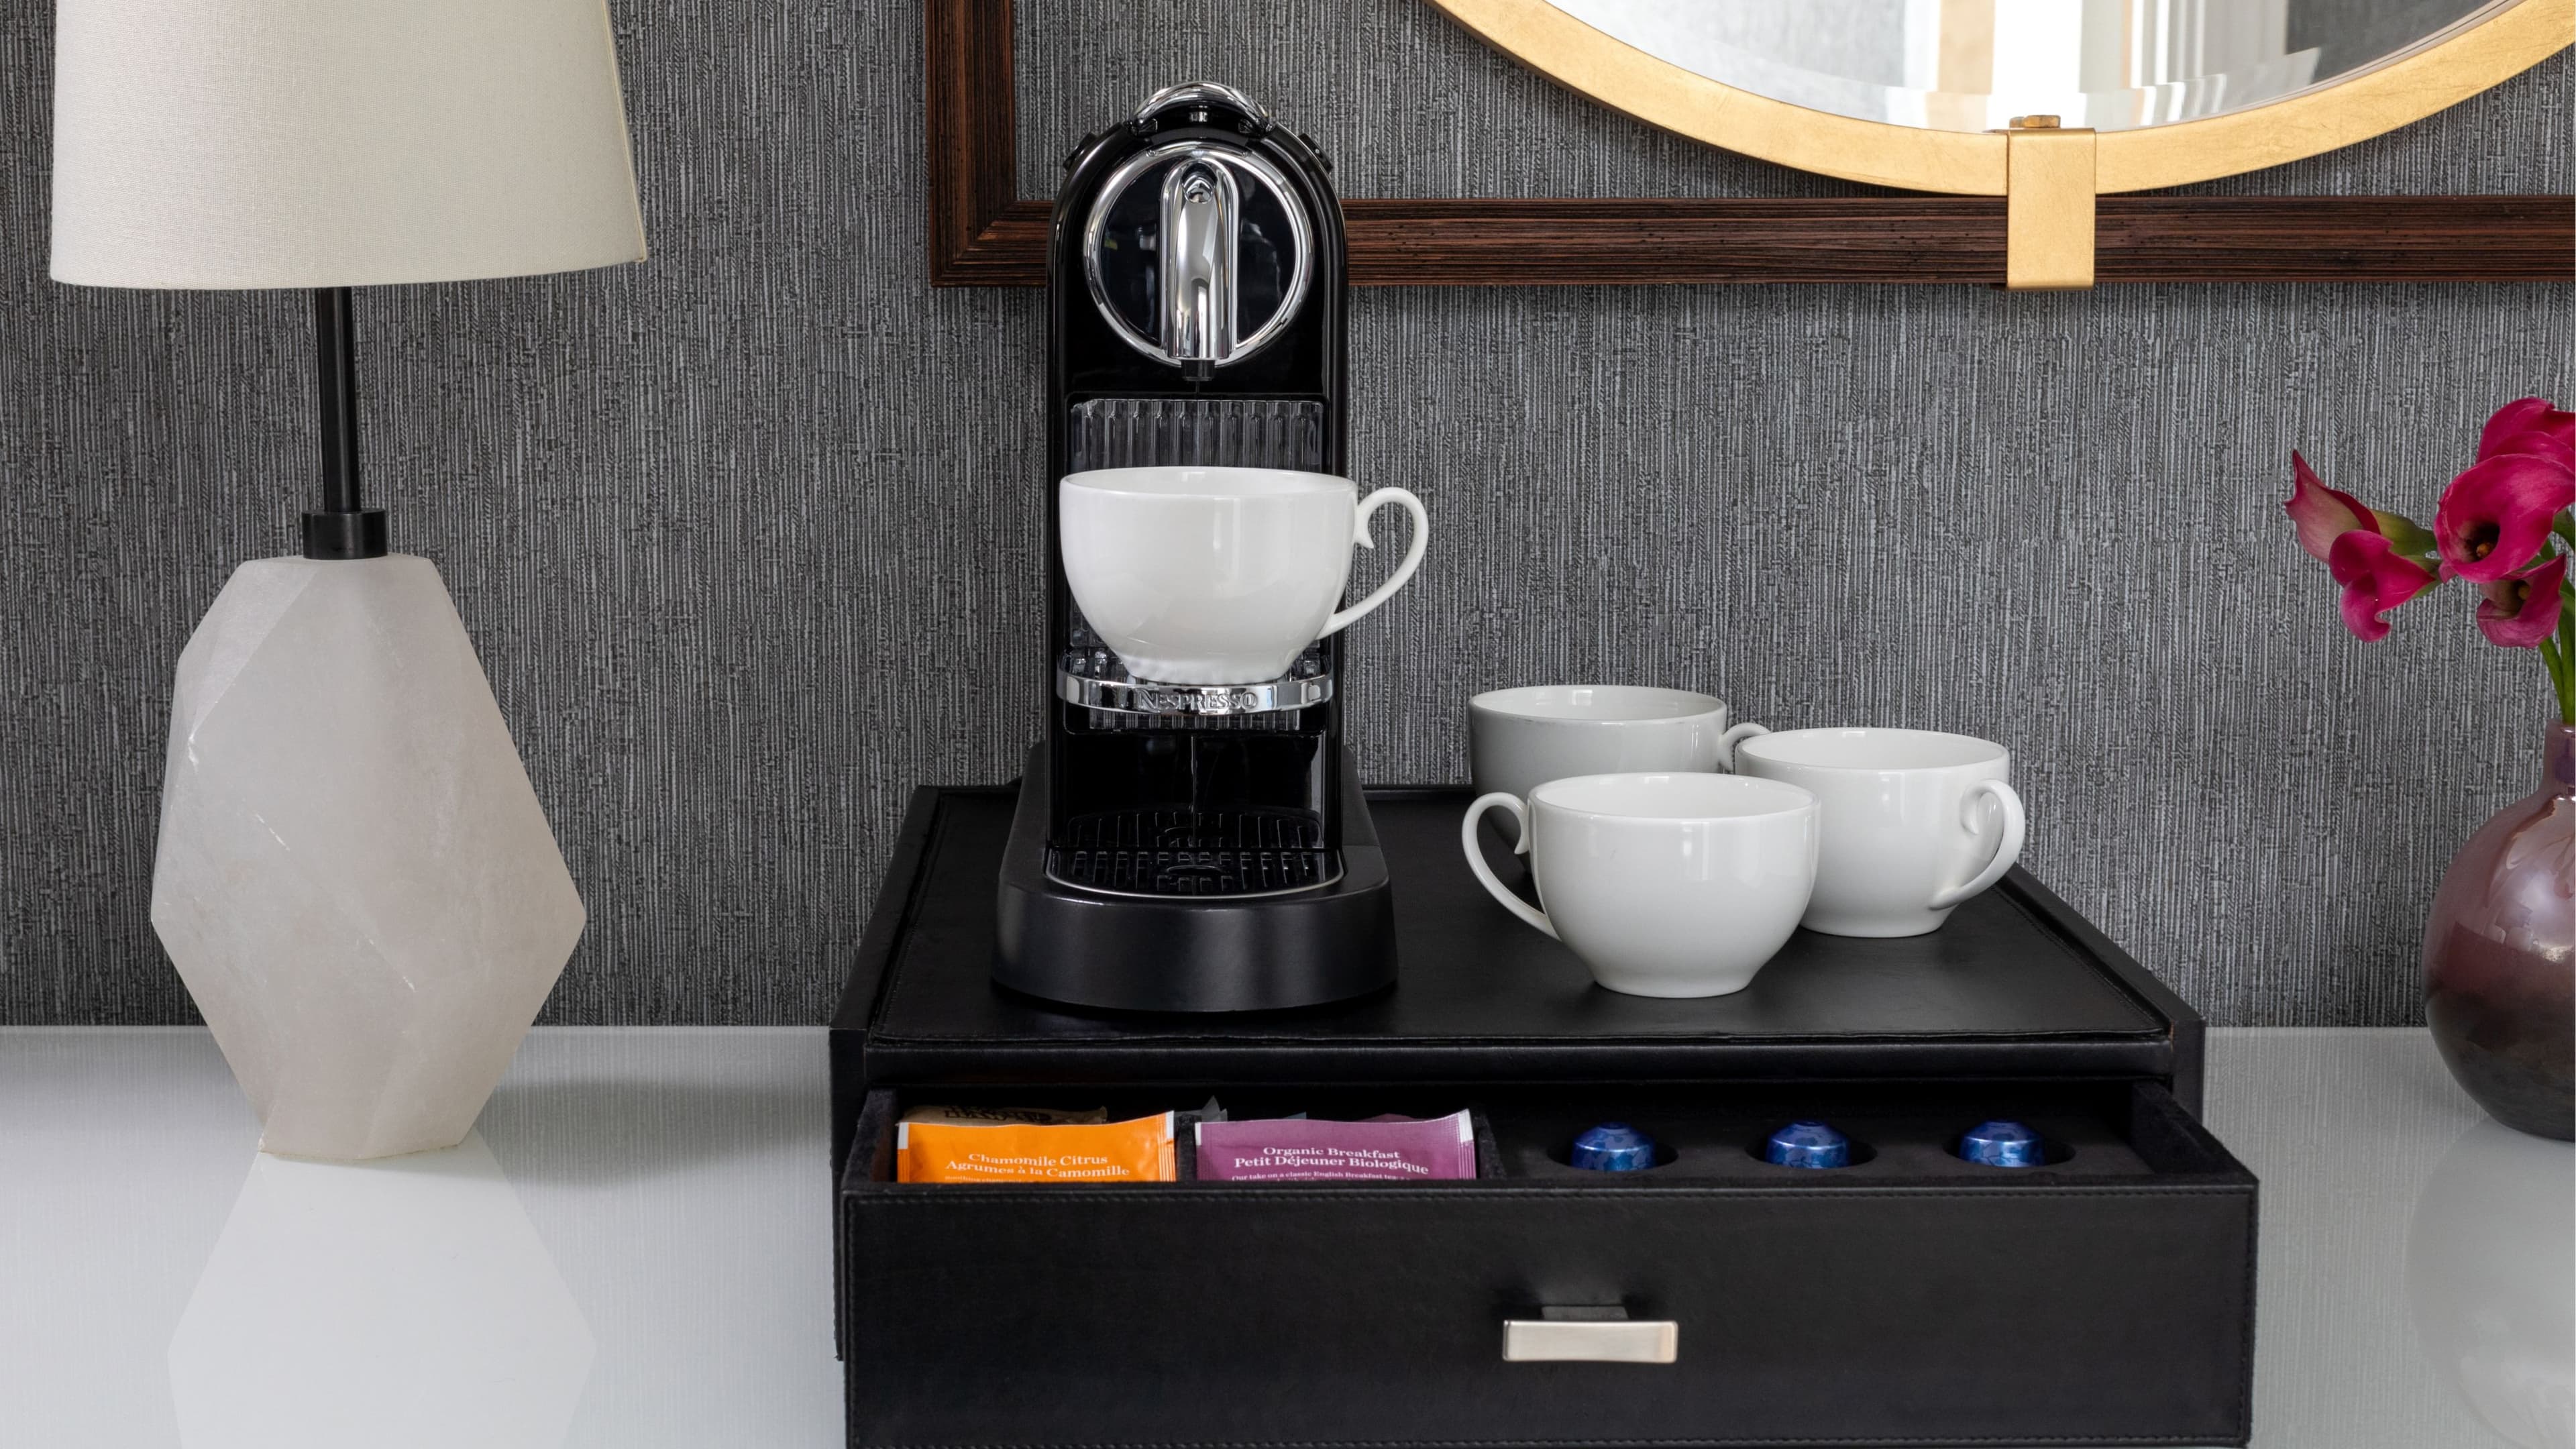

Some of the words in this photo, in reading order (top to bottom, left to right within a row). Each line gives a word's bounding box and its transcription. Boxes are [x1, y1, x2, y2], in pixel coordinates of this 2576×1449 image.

[1136, 688, 1258, 713] NESPRESSO
[968, 1153, 1057, 1167] Chamomile
[1059, 1155, 1108, 1166] Citrus
[1263, 1146, 1324, 1157] Organic
[1328, 1148, 1400, 1159] Breakfast
[945, 1161, 1014, 1174] Agrumes
[1018, 1166, 1026, 1175] à
[1030, 1167, 1043, 1175] la
[1046, 1165, 1130, 1178] Camomille
[1234, 1157, 1271, 1168] Petit
[1275, 1155, 1346, 1167] Déjeuner
[1348, 1157, 1429, 1175] Biologique
[1313, 1170, 1344, 1179] English
